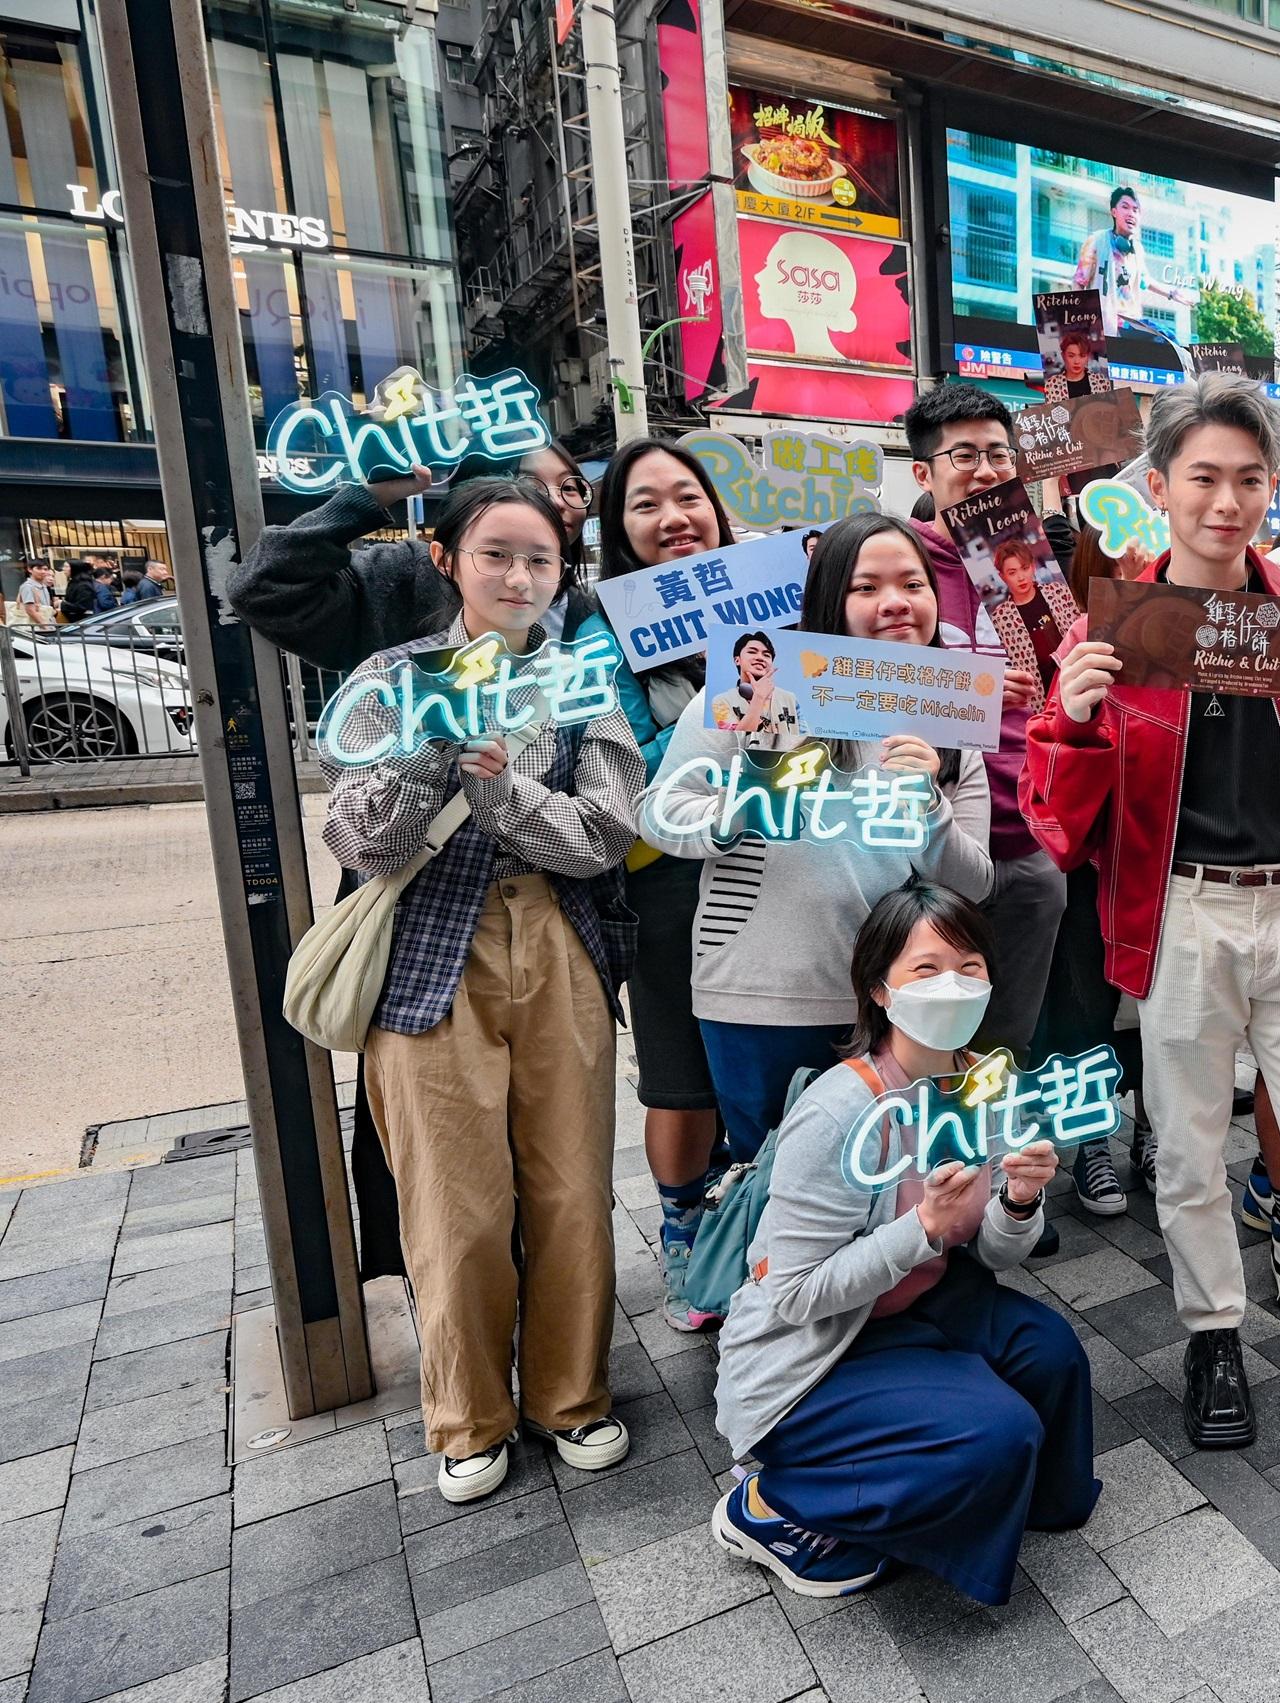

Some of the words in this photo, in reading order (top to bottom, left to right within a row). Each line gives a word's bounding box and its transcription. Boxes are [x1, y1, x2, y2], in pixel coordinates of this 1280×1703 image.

[795, 204, 816, 219] 2/F
[798, 290, 822, 305] 莎莎
[1037, 294, 1080, 312] Ritchie
[1064, 310, 1098, 325] Leong
[1192, 345, 1228, 360] Ritchie
[961, 361, 986, 374] JM
[1024, 449, 1054, 465] Ritchie
[1056, 447, 1064, 455] &
[1065, 441, 1084, 456] Chit
[946, 493, 1003, 528] Ritchie
[987, 508, 1030, 536] Leong
[629, 609, 708, 659] CHIT
[713, 583, 803, 625] WONG
[1193, 650, 1235, 670] Ritchie
[1239, 656, 1250, 669] &
[832, 656, 972, 691] 雞蛋仔或格仔餅
[812, 685, 918, 716] 不一定要吃
[920, 701, 986, 723] Michelin
